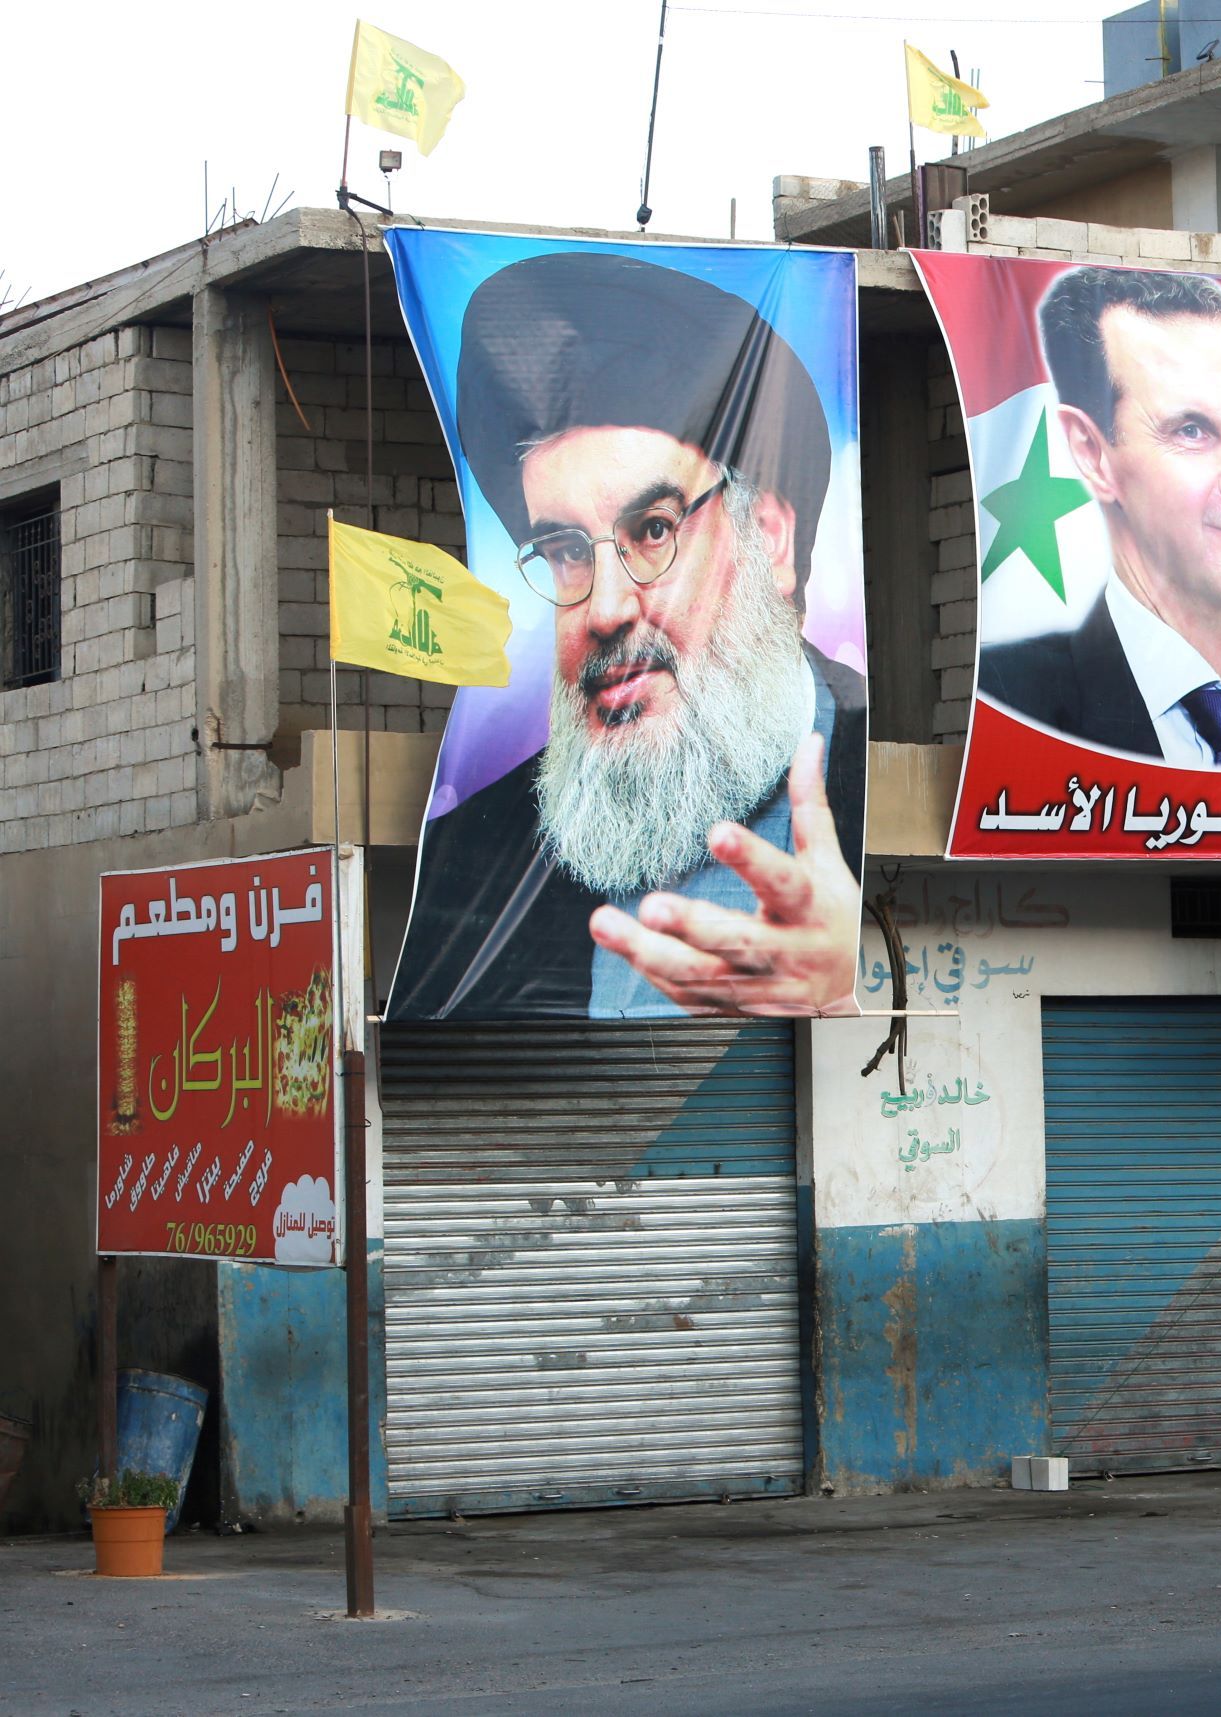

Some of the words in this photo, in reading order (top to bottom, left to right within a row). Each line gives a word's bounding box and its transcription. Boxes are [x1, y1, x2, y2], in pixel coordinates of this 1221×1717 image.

[979, 776, 1114, 832] الأسد
[112, 877, 237, 966] ومطعم
[248, 863, 323, 948] فرن
[149, 975, 275, 1130] البركان
[938, 1077, 990, 1105] خالد
[151, 1144, 180, 1201] فاهيتا
[175, 1142, 202, 1202] مناقيش
[224, 1140, 254, 1200] صفيحة
[249, 1148, 272, 1206] فروج
[899, 1127, 961, 1172] السوقي
[105, 1154, 132, 1209] شاورما
[196, 1156, 221, 1204] بيتزا
[166, 1222, 257, 1256] 76/965929
[276, 1211, 306, 1238] للمنازل
